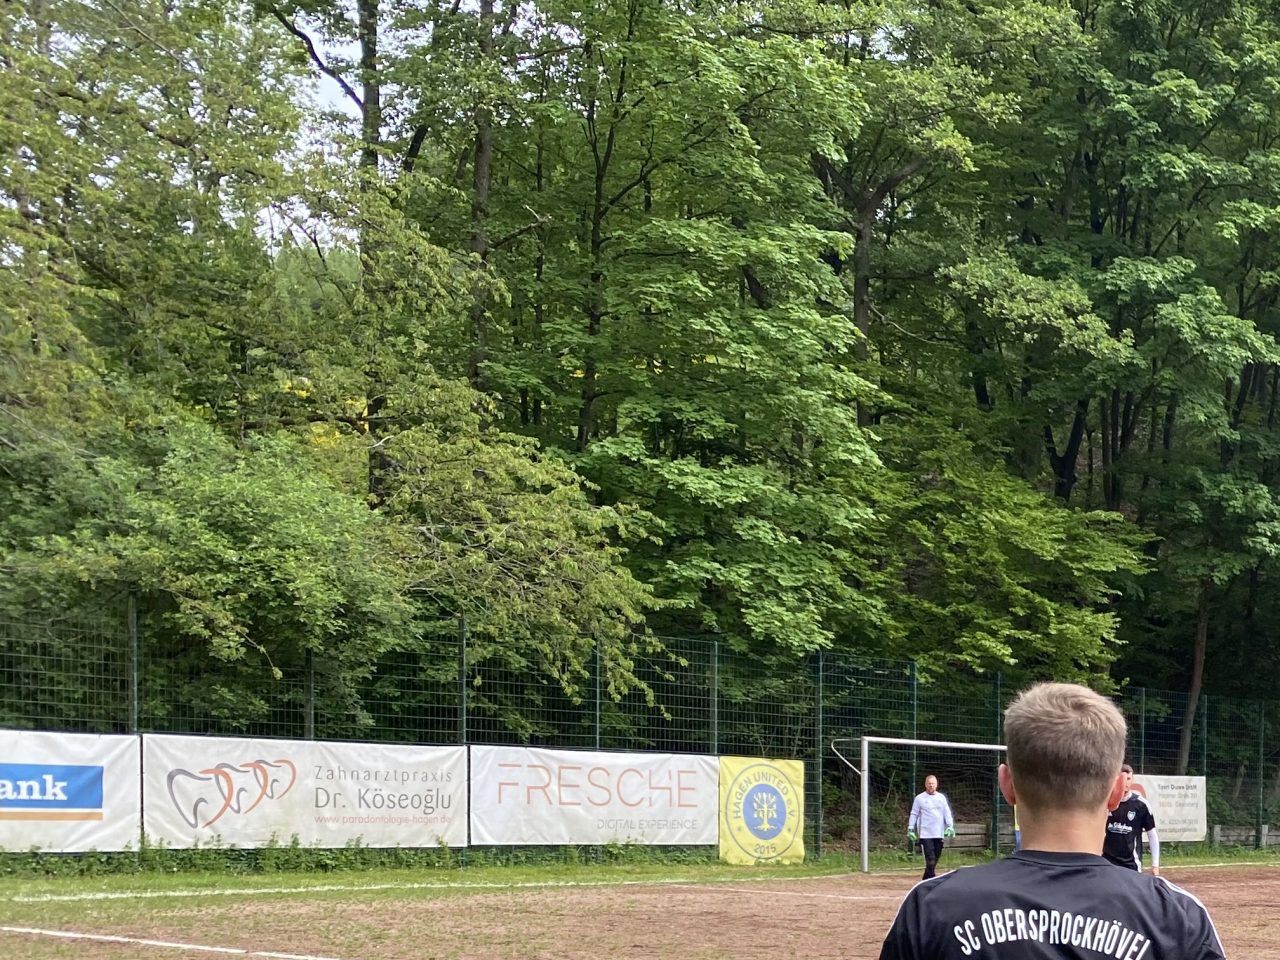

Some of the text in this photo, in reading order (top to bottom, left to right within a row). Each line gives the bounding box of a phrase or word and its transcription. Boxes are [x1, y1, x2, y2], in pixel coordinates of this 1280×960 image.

[314, 765, 453, 785] Zahnarztpraxis
[498, 764, 698, 808] FRESCHE
[314, 787, 346, 809] Dr.
[733, 776, 753, 819] HAGEN
[753, 771, 789, 795] UNITED
[597, 818, 698, 830] DIGITAL EXPERIENCE
[754, 843, 777, 855] 2015
[953, 919, 981, 955] SC
